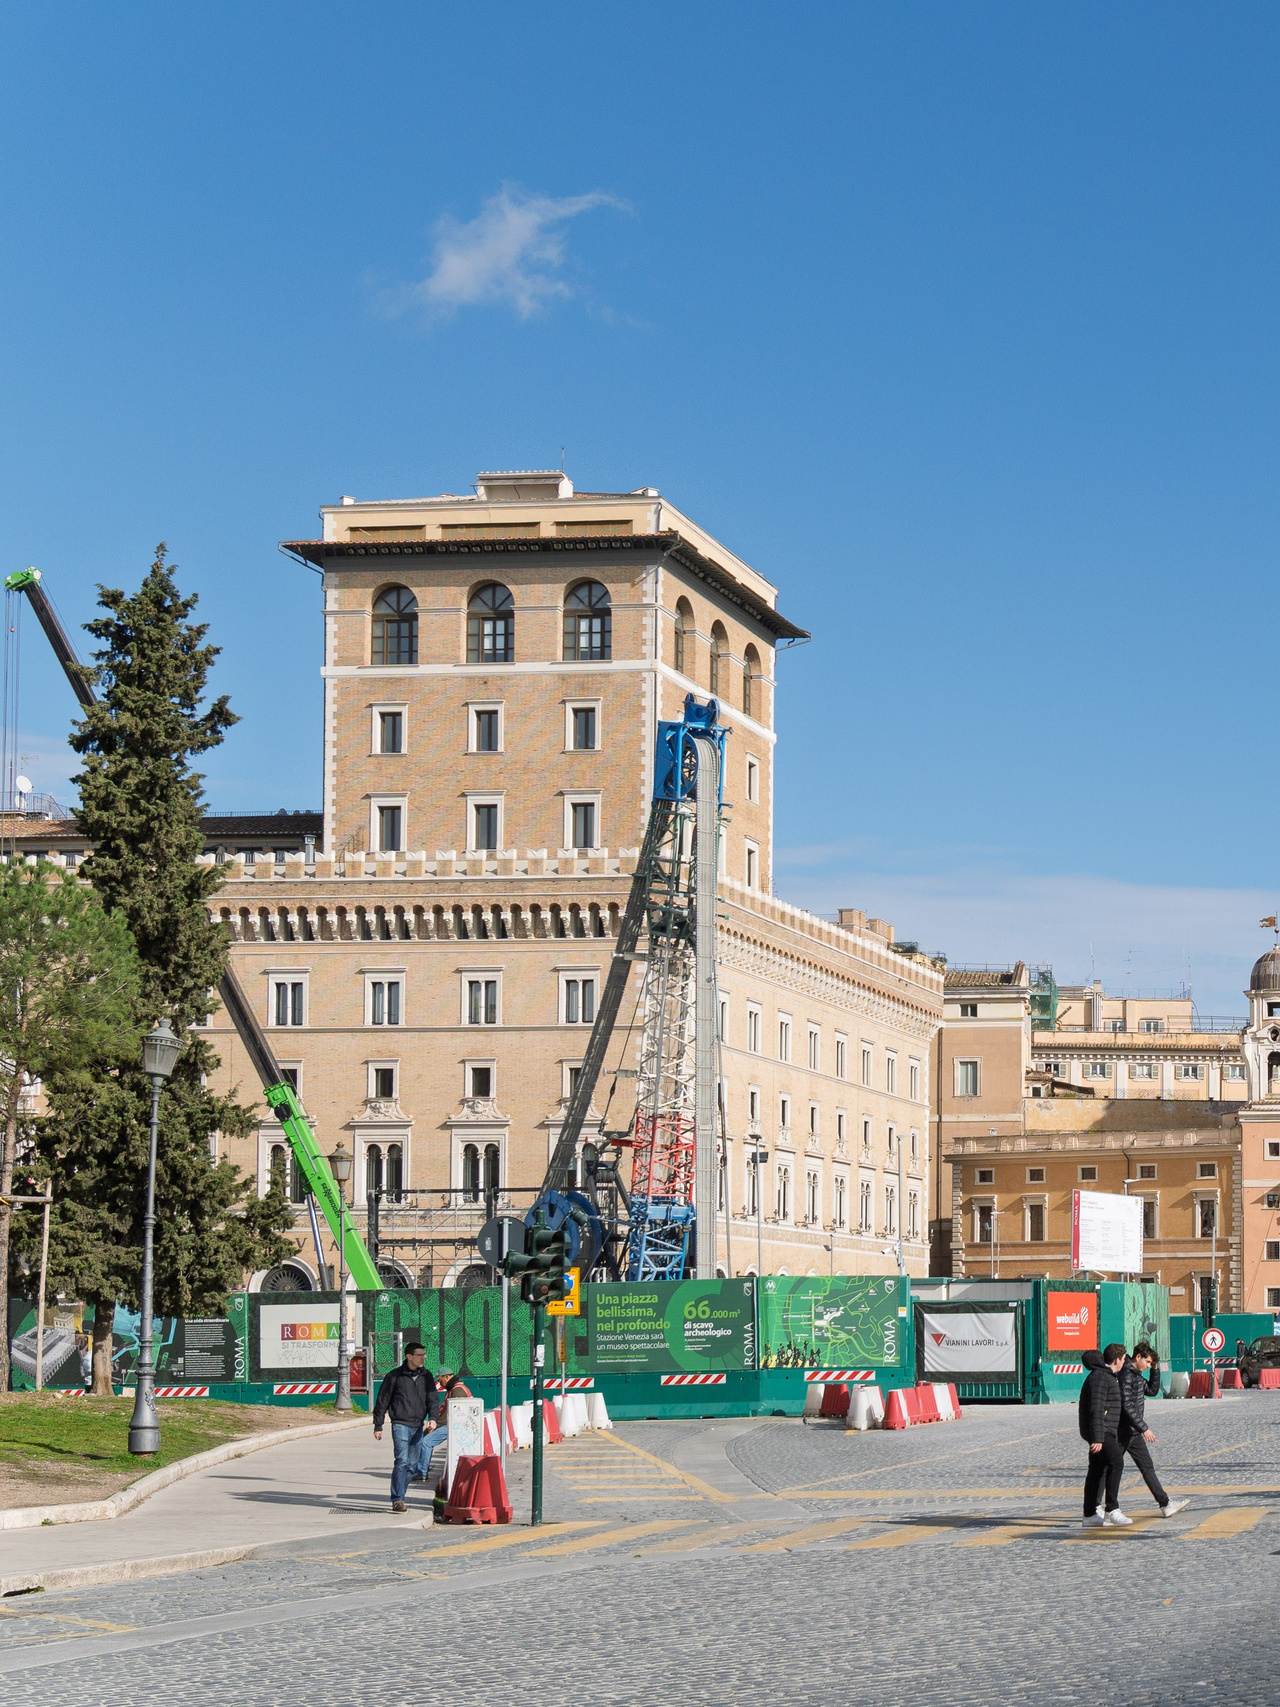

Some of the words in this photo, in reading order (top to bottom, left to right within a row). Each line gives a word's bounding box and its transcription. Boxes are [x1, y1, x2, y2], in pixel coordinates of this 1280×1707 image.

[596, 1294, 619, 1304] Una
[622, 1292, 658, 1306] piazza
[596, 1306, 656, 1318] bellissima,
[1056, 1313, 1080, 1324] webuild
[284, 1326, 338, 1338] ROMA
[597, 1320, 614, 1331] nel
[616, 1318, 671, 1333] profondo
[684, 1328, 732, 1337] archeologico
[630, 1342, 670, 1350] spettacolare
[744, 1322, 754, 1365] ROMA
[884, 1319, 896, 1362] ROMA
[234, 1336, 244, 1378] ROMA
